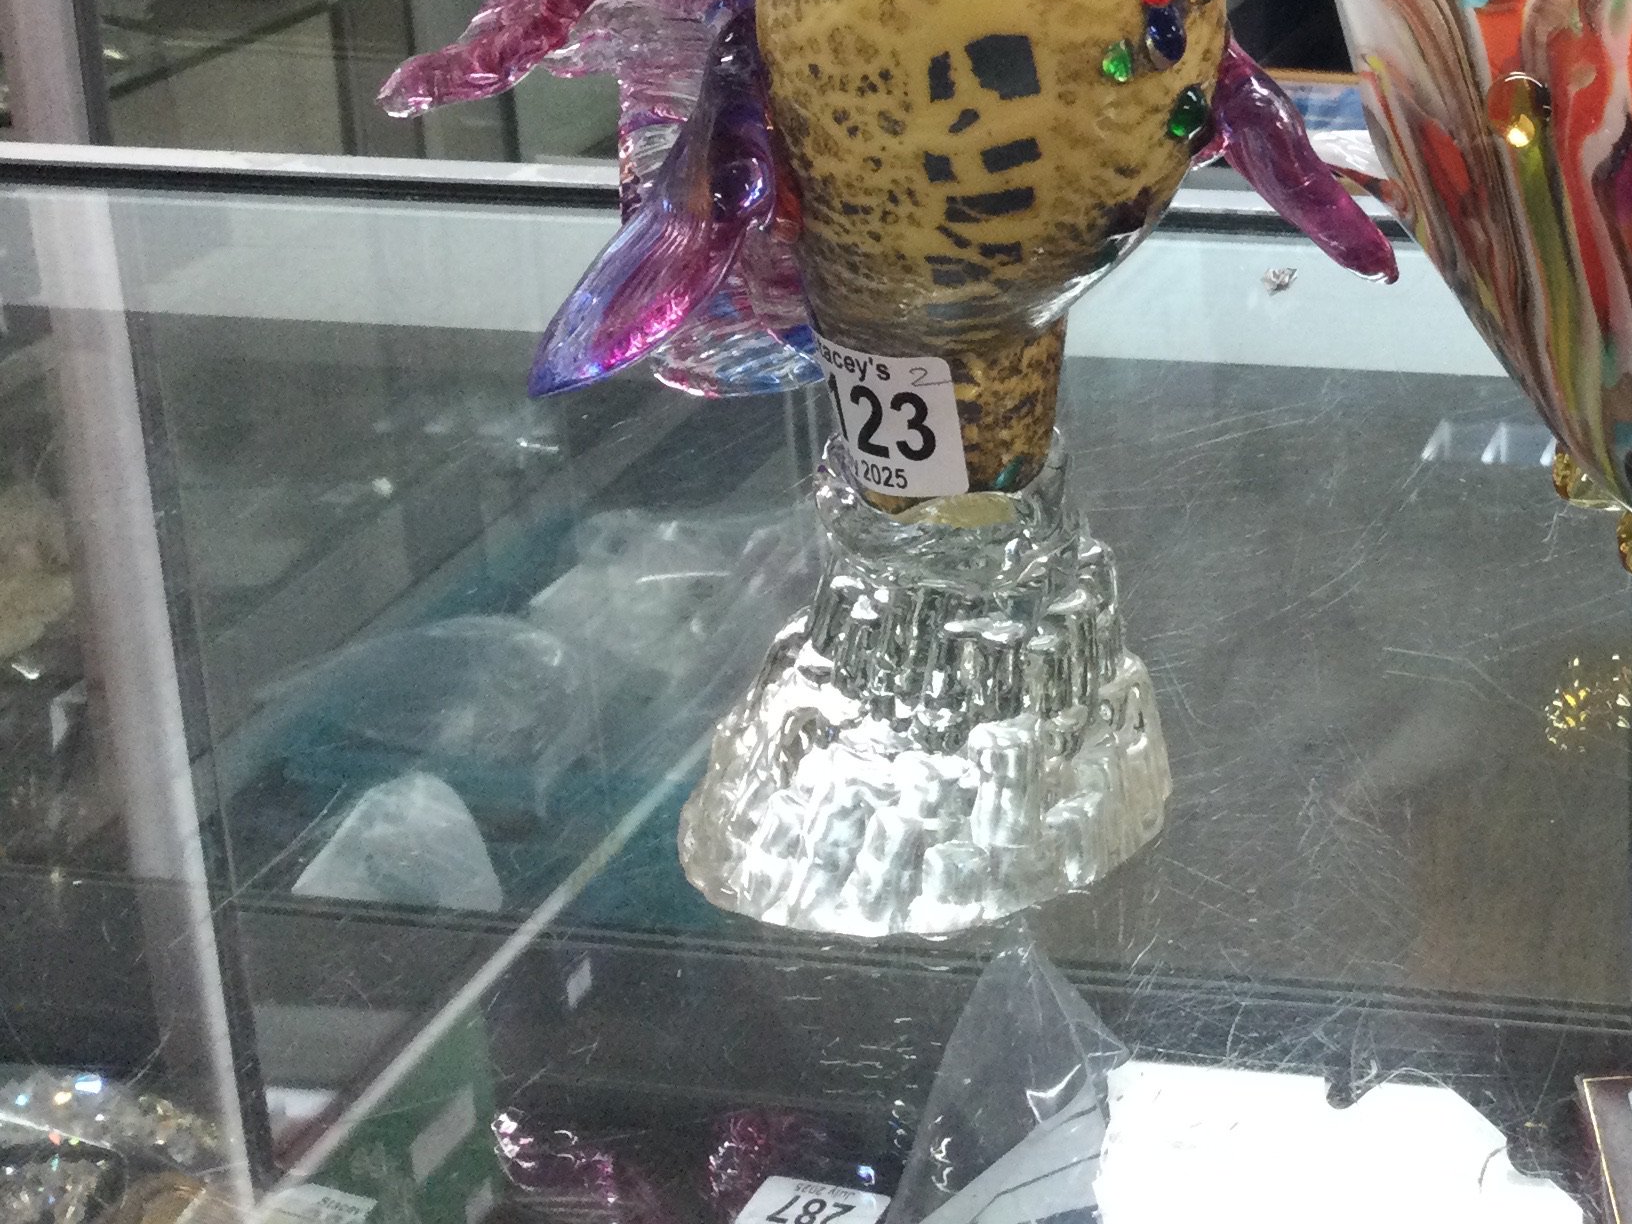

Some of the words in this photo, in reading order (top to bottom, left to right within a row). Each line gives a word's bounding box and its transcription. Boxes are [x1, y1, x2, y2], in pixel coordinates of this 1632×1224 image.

[815, 338, 891, 382] tacey's
[859, 459, 909, 490] 2025
[765, 1194, 856, 1224] 287
